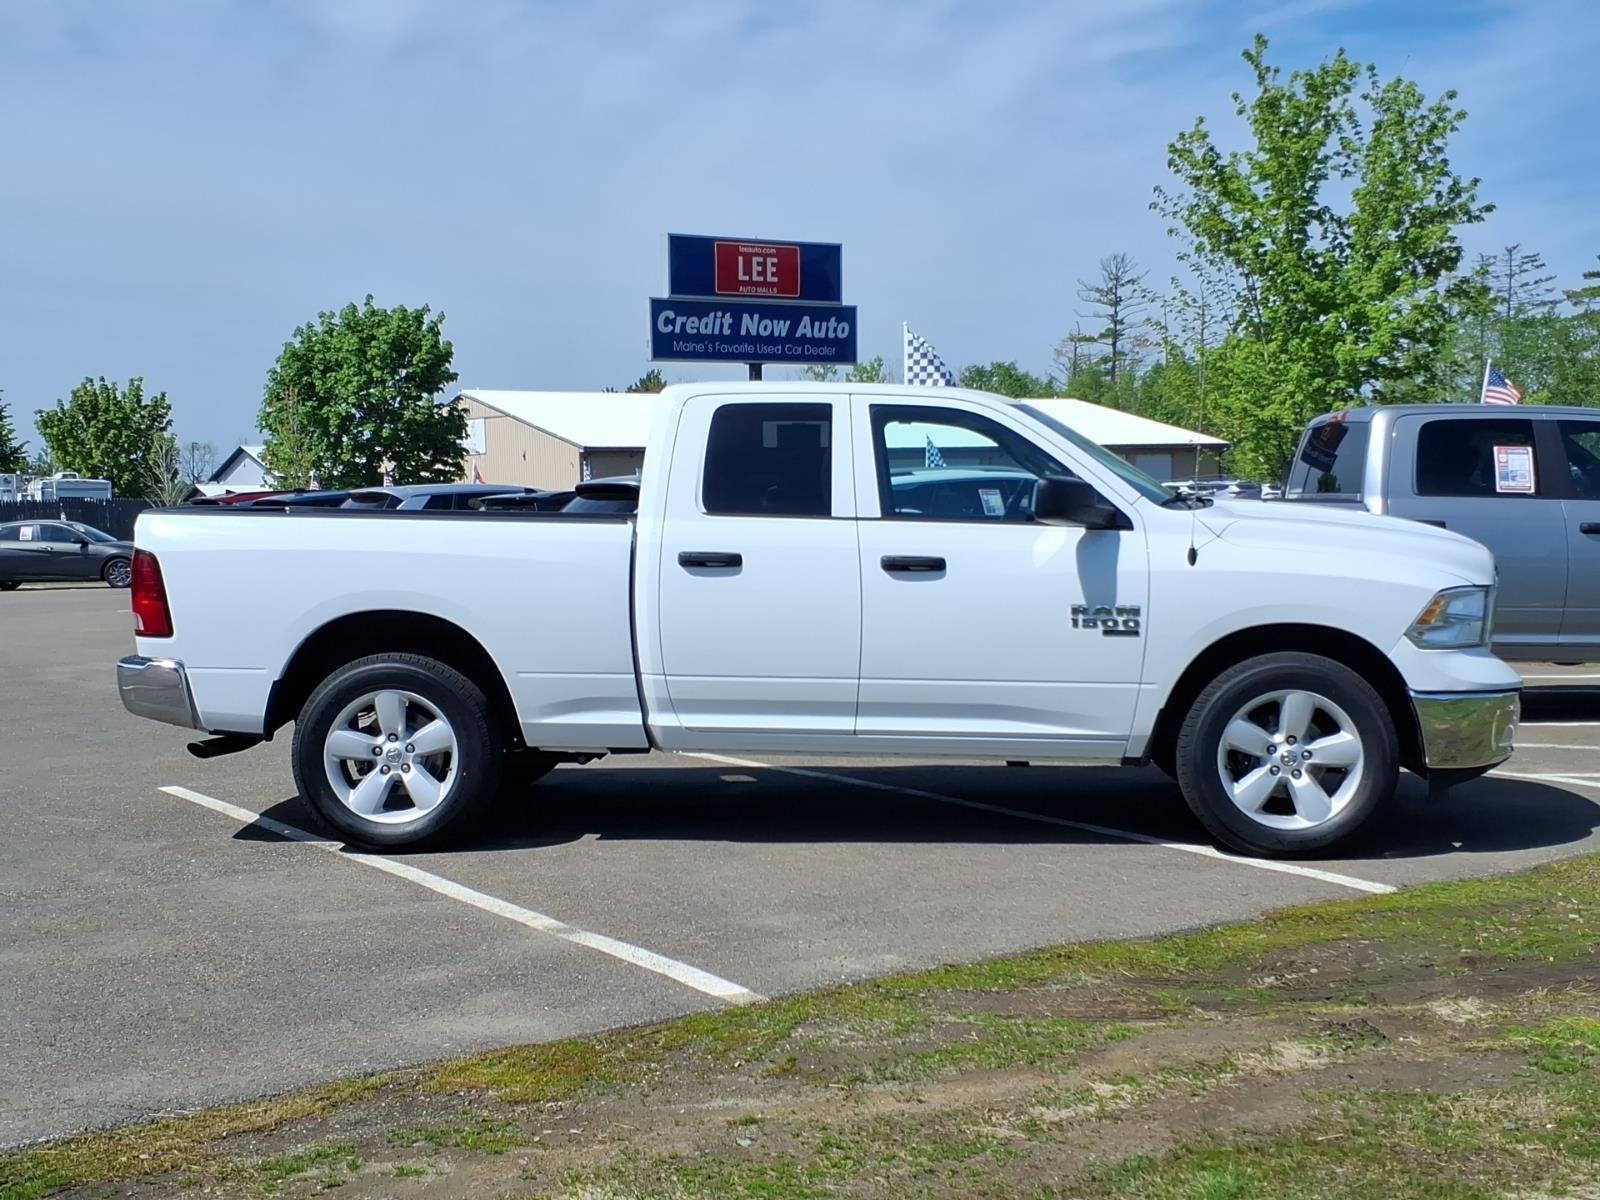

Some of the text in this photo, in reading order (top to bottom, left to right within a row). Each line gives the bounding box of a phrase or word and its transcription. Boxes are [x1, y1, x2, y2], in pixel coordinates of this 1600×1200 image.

[738, 256, 778, 282] LEE
[657, 310, 850, 339] Credit Now Auto
[673, 341, 836, 356] Maine's Favorite Used Car Dealer
[1071, 605, 1141, 617] RAM
[1071, 617, 1141, 630] 1500
